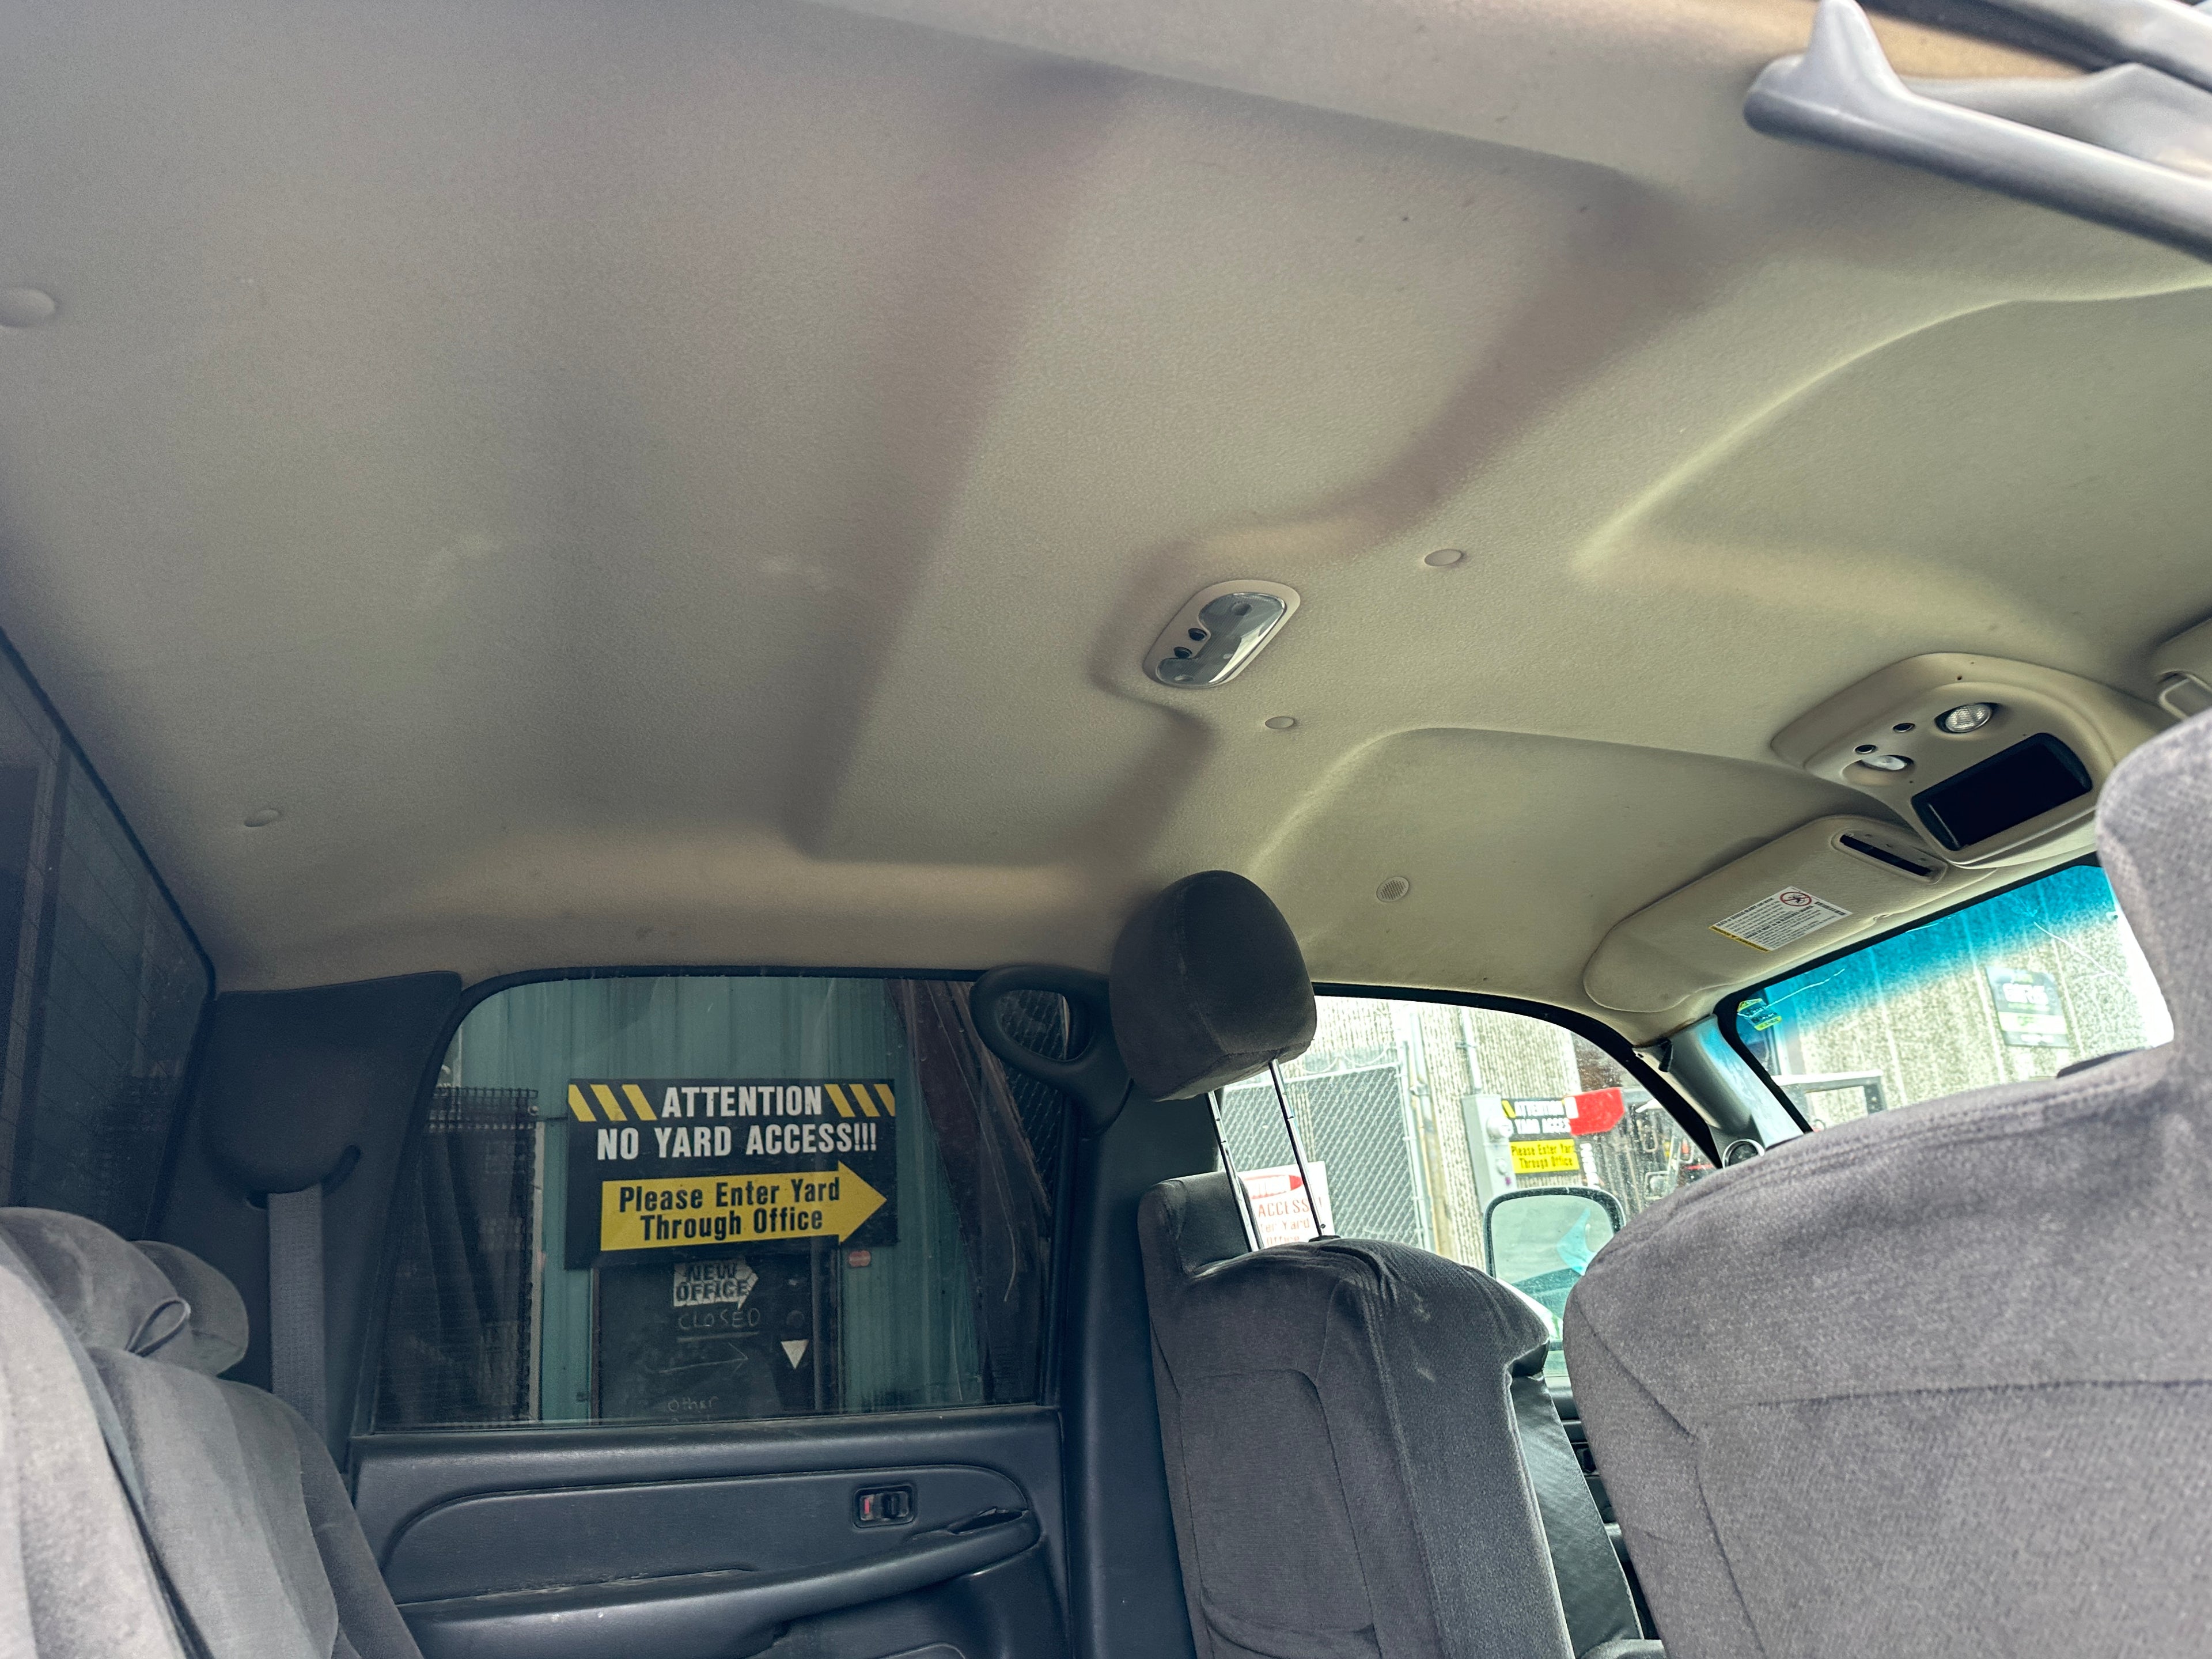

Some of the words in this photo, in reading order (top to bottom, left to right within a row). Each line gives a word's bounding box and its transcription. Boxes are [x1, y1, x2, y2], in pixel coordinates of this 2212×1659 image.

[661, 1085, 822, 1118] ATTENTION
[597, 1127, 639, 1160] NO
[654, 1126, 732, 1158] YARD
[745, 1123, 877, 1156] ACCESS!!!
[1511, 1145, 1535, 1157] Please
[1537, 1143, 1557, 1155] Enter
[1518, 1157, 1548, 1169] Through
[1551, 1156, 1573, 1167] Office
[620, 1185, 703, 1213] Please
[716, 1181, 779, 1207] Enter
[790, 1176, 840, 1203] Yard
[640, 1210, 741, 1241] Through
[753, 1206, 823, 1234] Office
[685, 1263, 737, 1282] NEW
[675, 1279, 751, 1302] OFFICE
[677, 1308, 762, 1330] CLOSED
